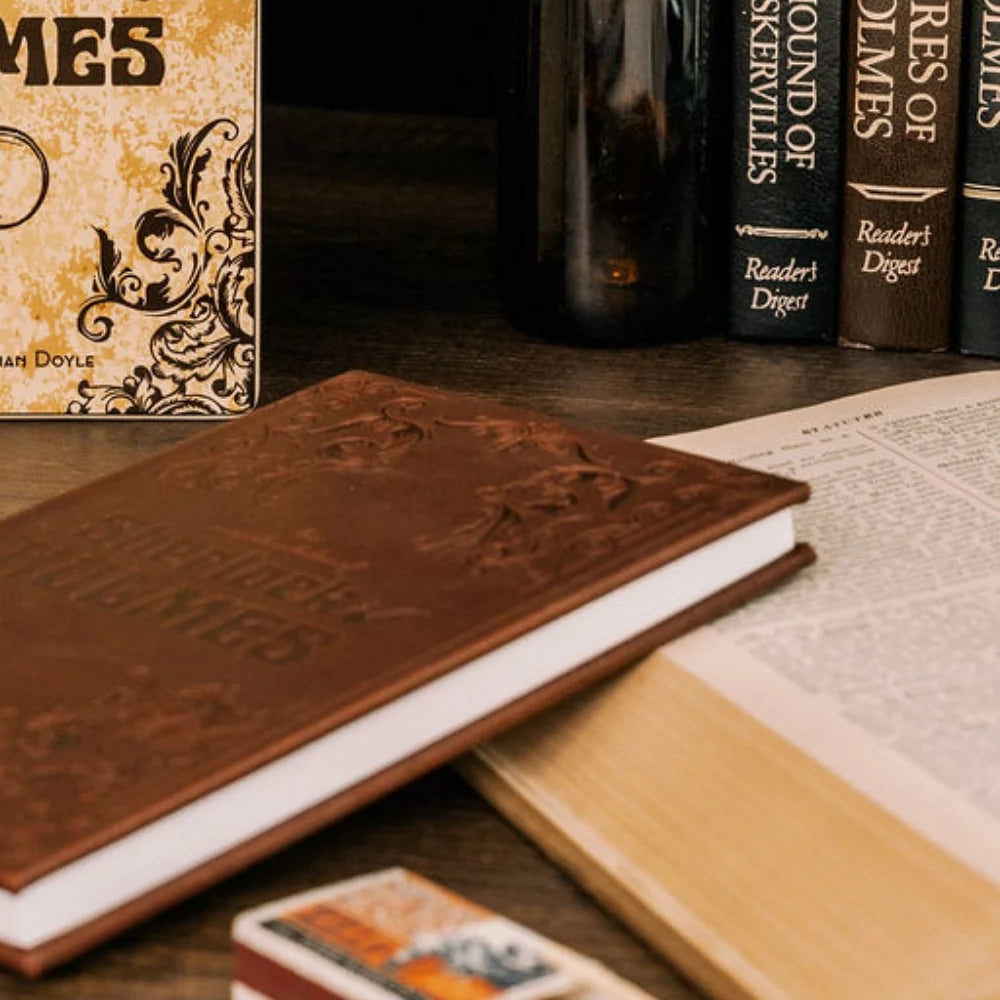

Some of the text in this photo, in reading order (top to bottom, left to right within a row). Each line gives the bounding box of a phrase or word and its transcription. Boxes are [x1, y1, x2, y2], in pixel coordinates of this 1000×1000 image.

[905, 93, 937, 143] OF
[785, 123, 815, 169] OF
[861, 251, 922, 283] Digest
[750, 287, 809, 318] Digest
[35, 350, 95, 368] DOYLE
